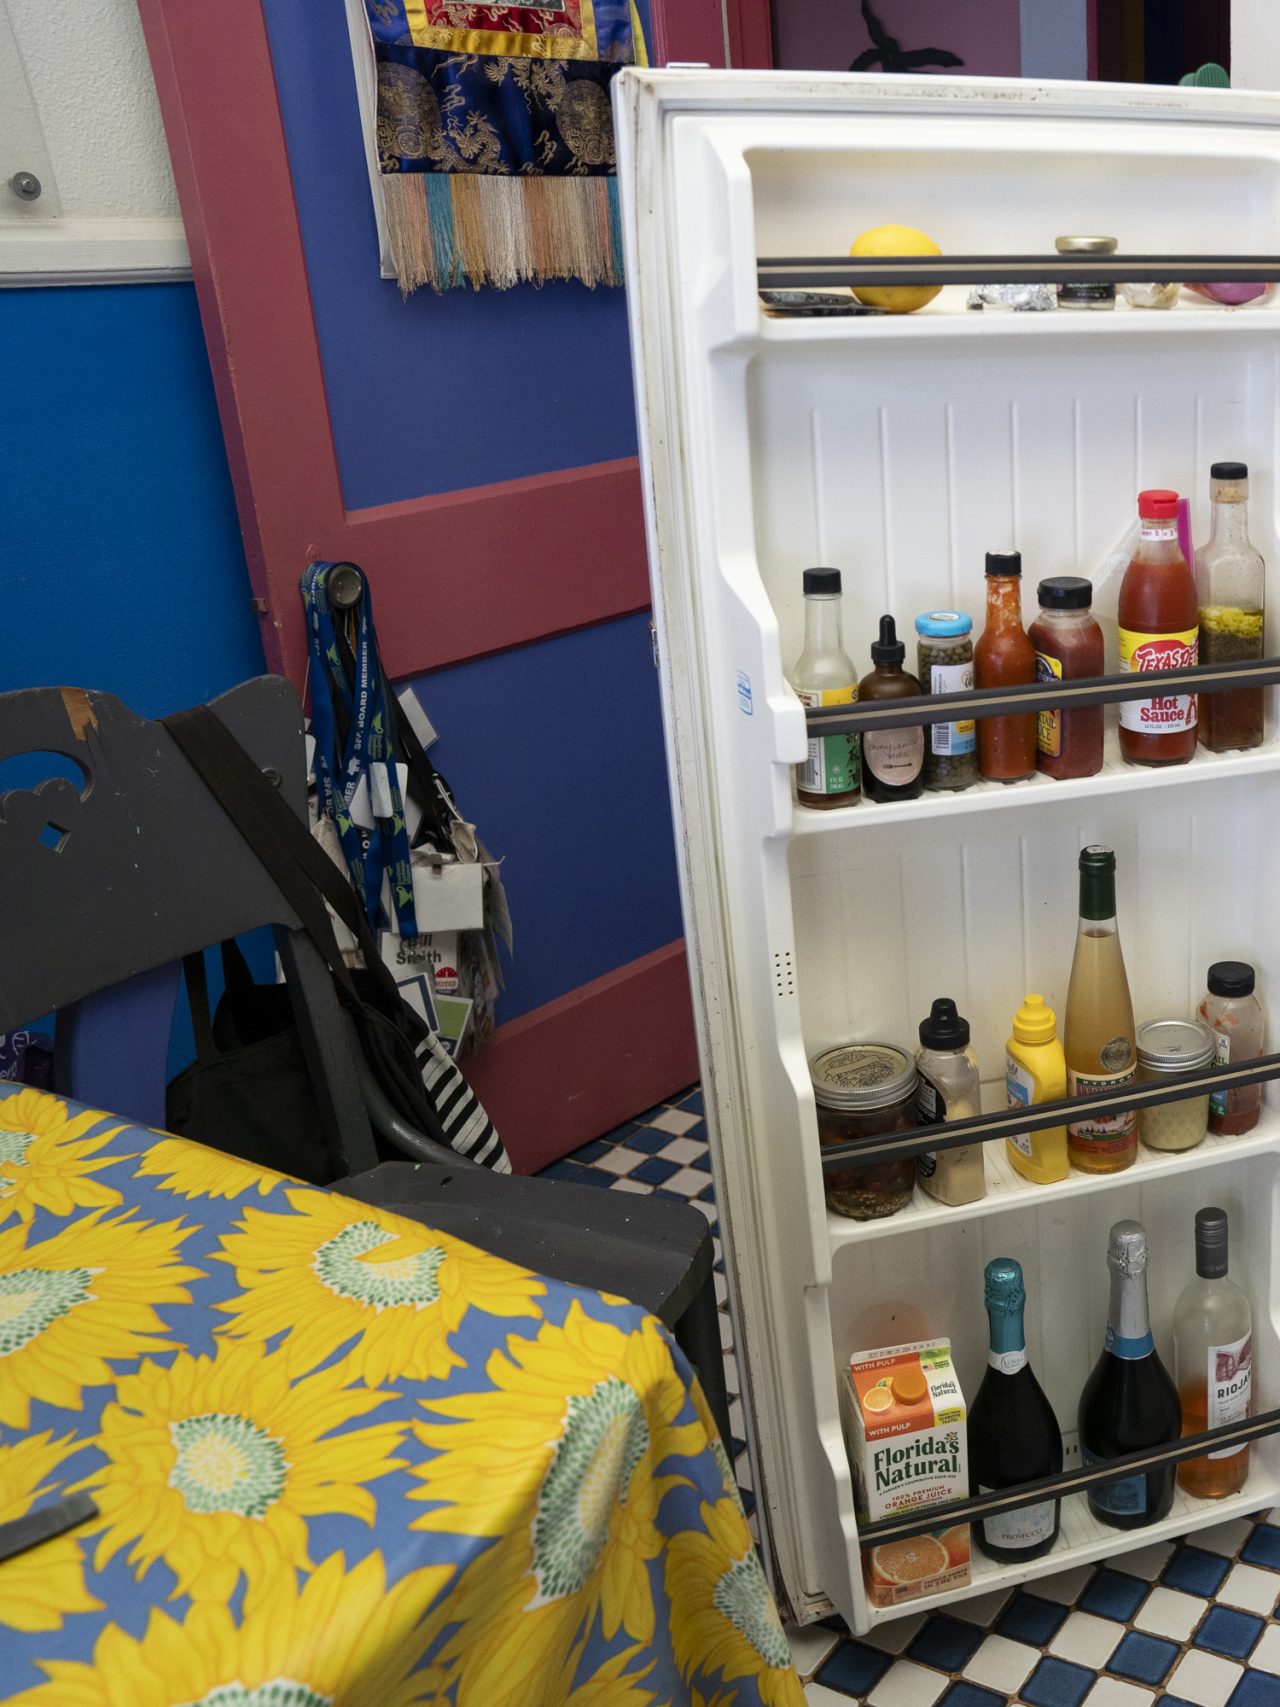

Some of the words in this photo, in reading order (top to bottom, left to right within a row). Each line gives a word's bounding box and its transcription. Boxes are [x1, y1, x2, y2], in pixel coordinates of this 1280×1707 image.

[358, 690, 368, 728] BOARD
[1151, 695, 1178, 710] Hot
[1140, 708, 1184, 723] Sauce
[854, 1363, 875, 1372] WITH
[876, 1358, 896, 1367] PULP
[932, 1388, 957, 1398] Natural
[869, 1427, 890, 1437] WITH
[891, 1422, 912, 1431] PULP
[875, 1455, 958, 1491] Natural
[885, 1495, 922, 1510] ORANGE
[926, 1488, 953, 1499] JUICE
[892, 1493, 911, 1501] 100%
[912, 1485, 945, 1496] PREMIUM
[1001, 1528, 1042, 1540] PROSECCO
